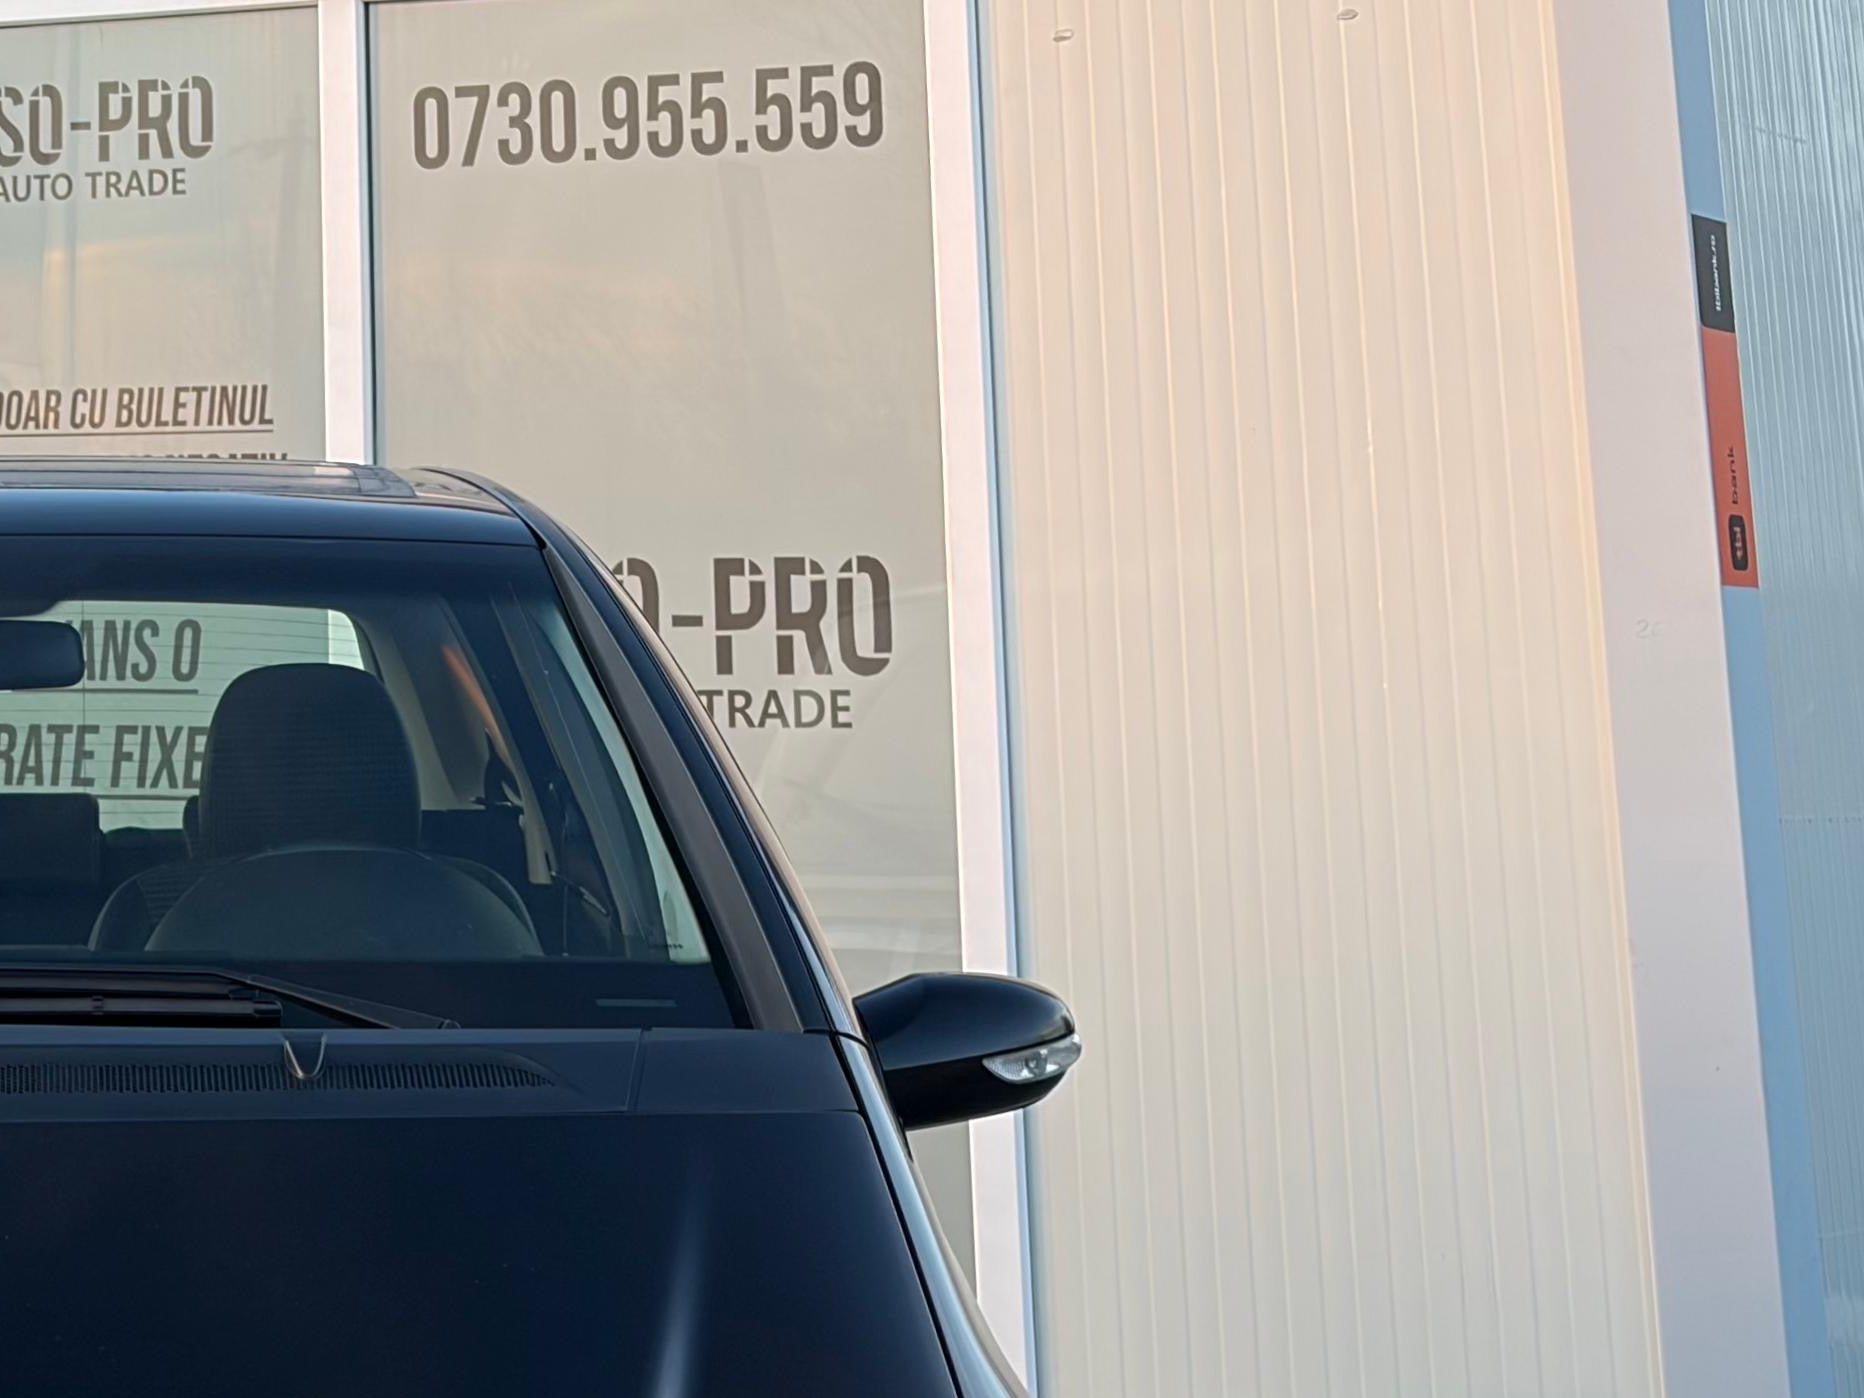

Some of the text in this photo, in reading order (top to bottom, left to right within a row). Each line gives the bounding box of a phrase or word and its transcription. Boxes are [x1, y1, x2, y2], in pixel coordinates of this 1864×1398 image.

[414, 61, 884, 169] 0730.955.559
[85, 168, 187, 199] TRADE
[70, 388, 108, 429] CU
[116, 384, 274, 428] BULETINUL
[697, 689, 853, 729] TRADE
